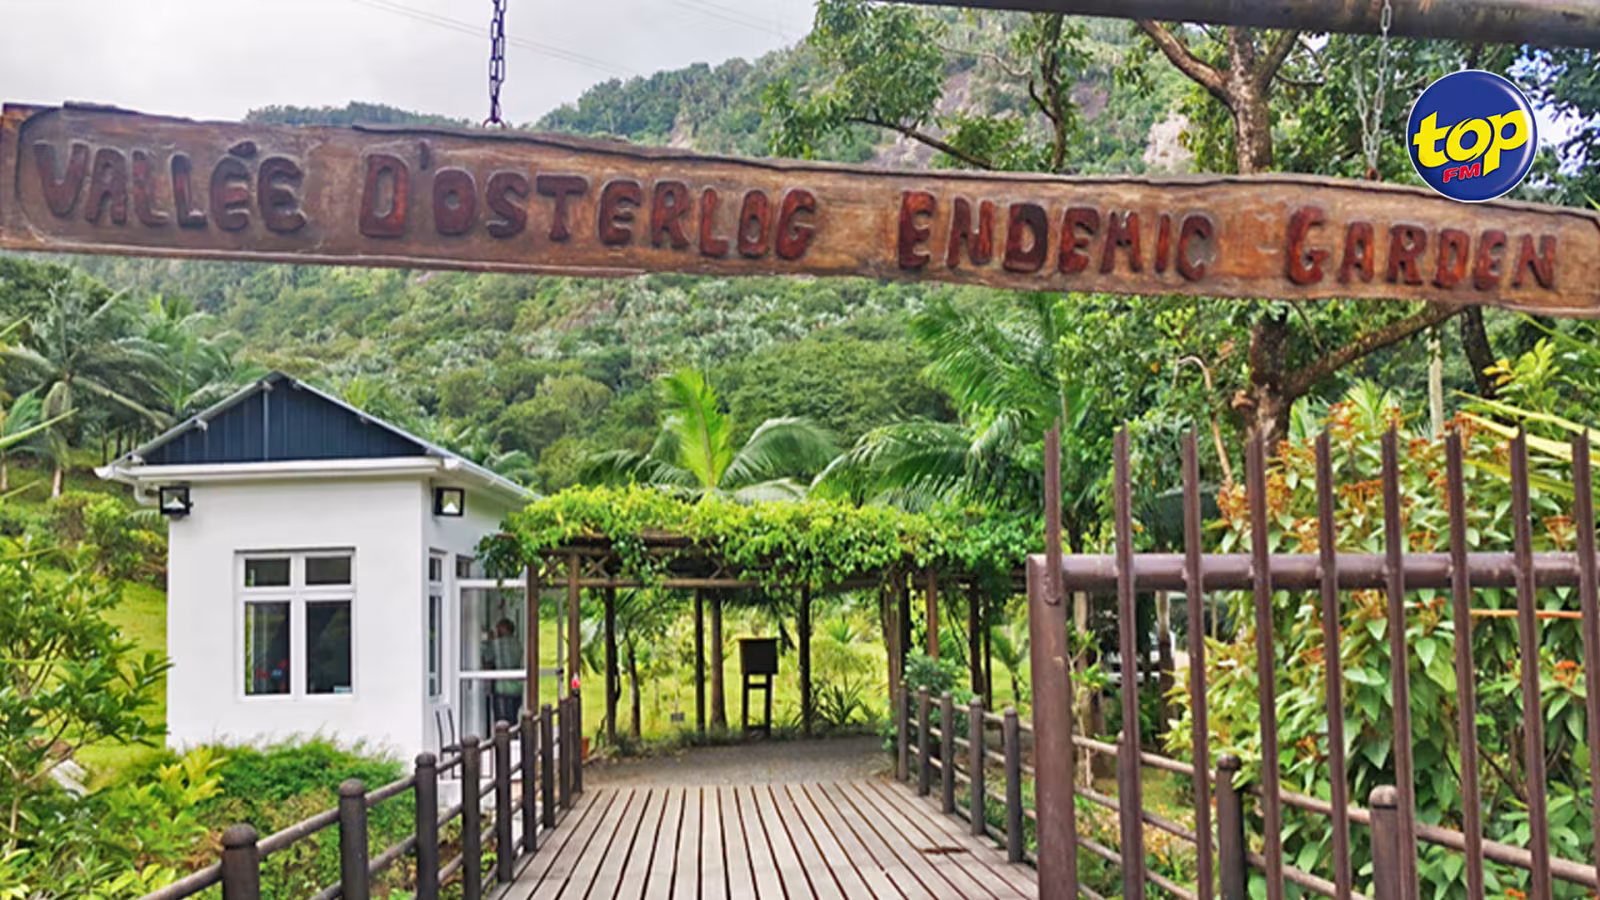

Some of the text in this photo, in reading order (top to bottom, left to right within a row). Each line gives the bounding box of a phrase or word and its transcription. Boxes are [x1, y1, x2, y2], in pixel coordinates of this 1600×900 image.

[33, 139, 1559, 290] VALLÉE D'OSTERLOG ENDEMIC GARDEN
